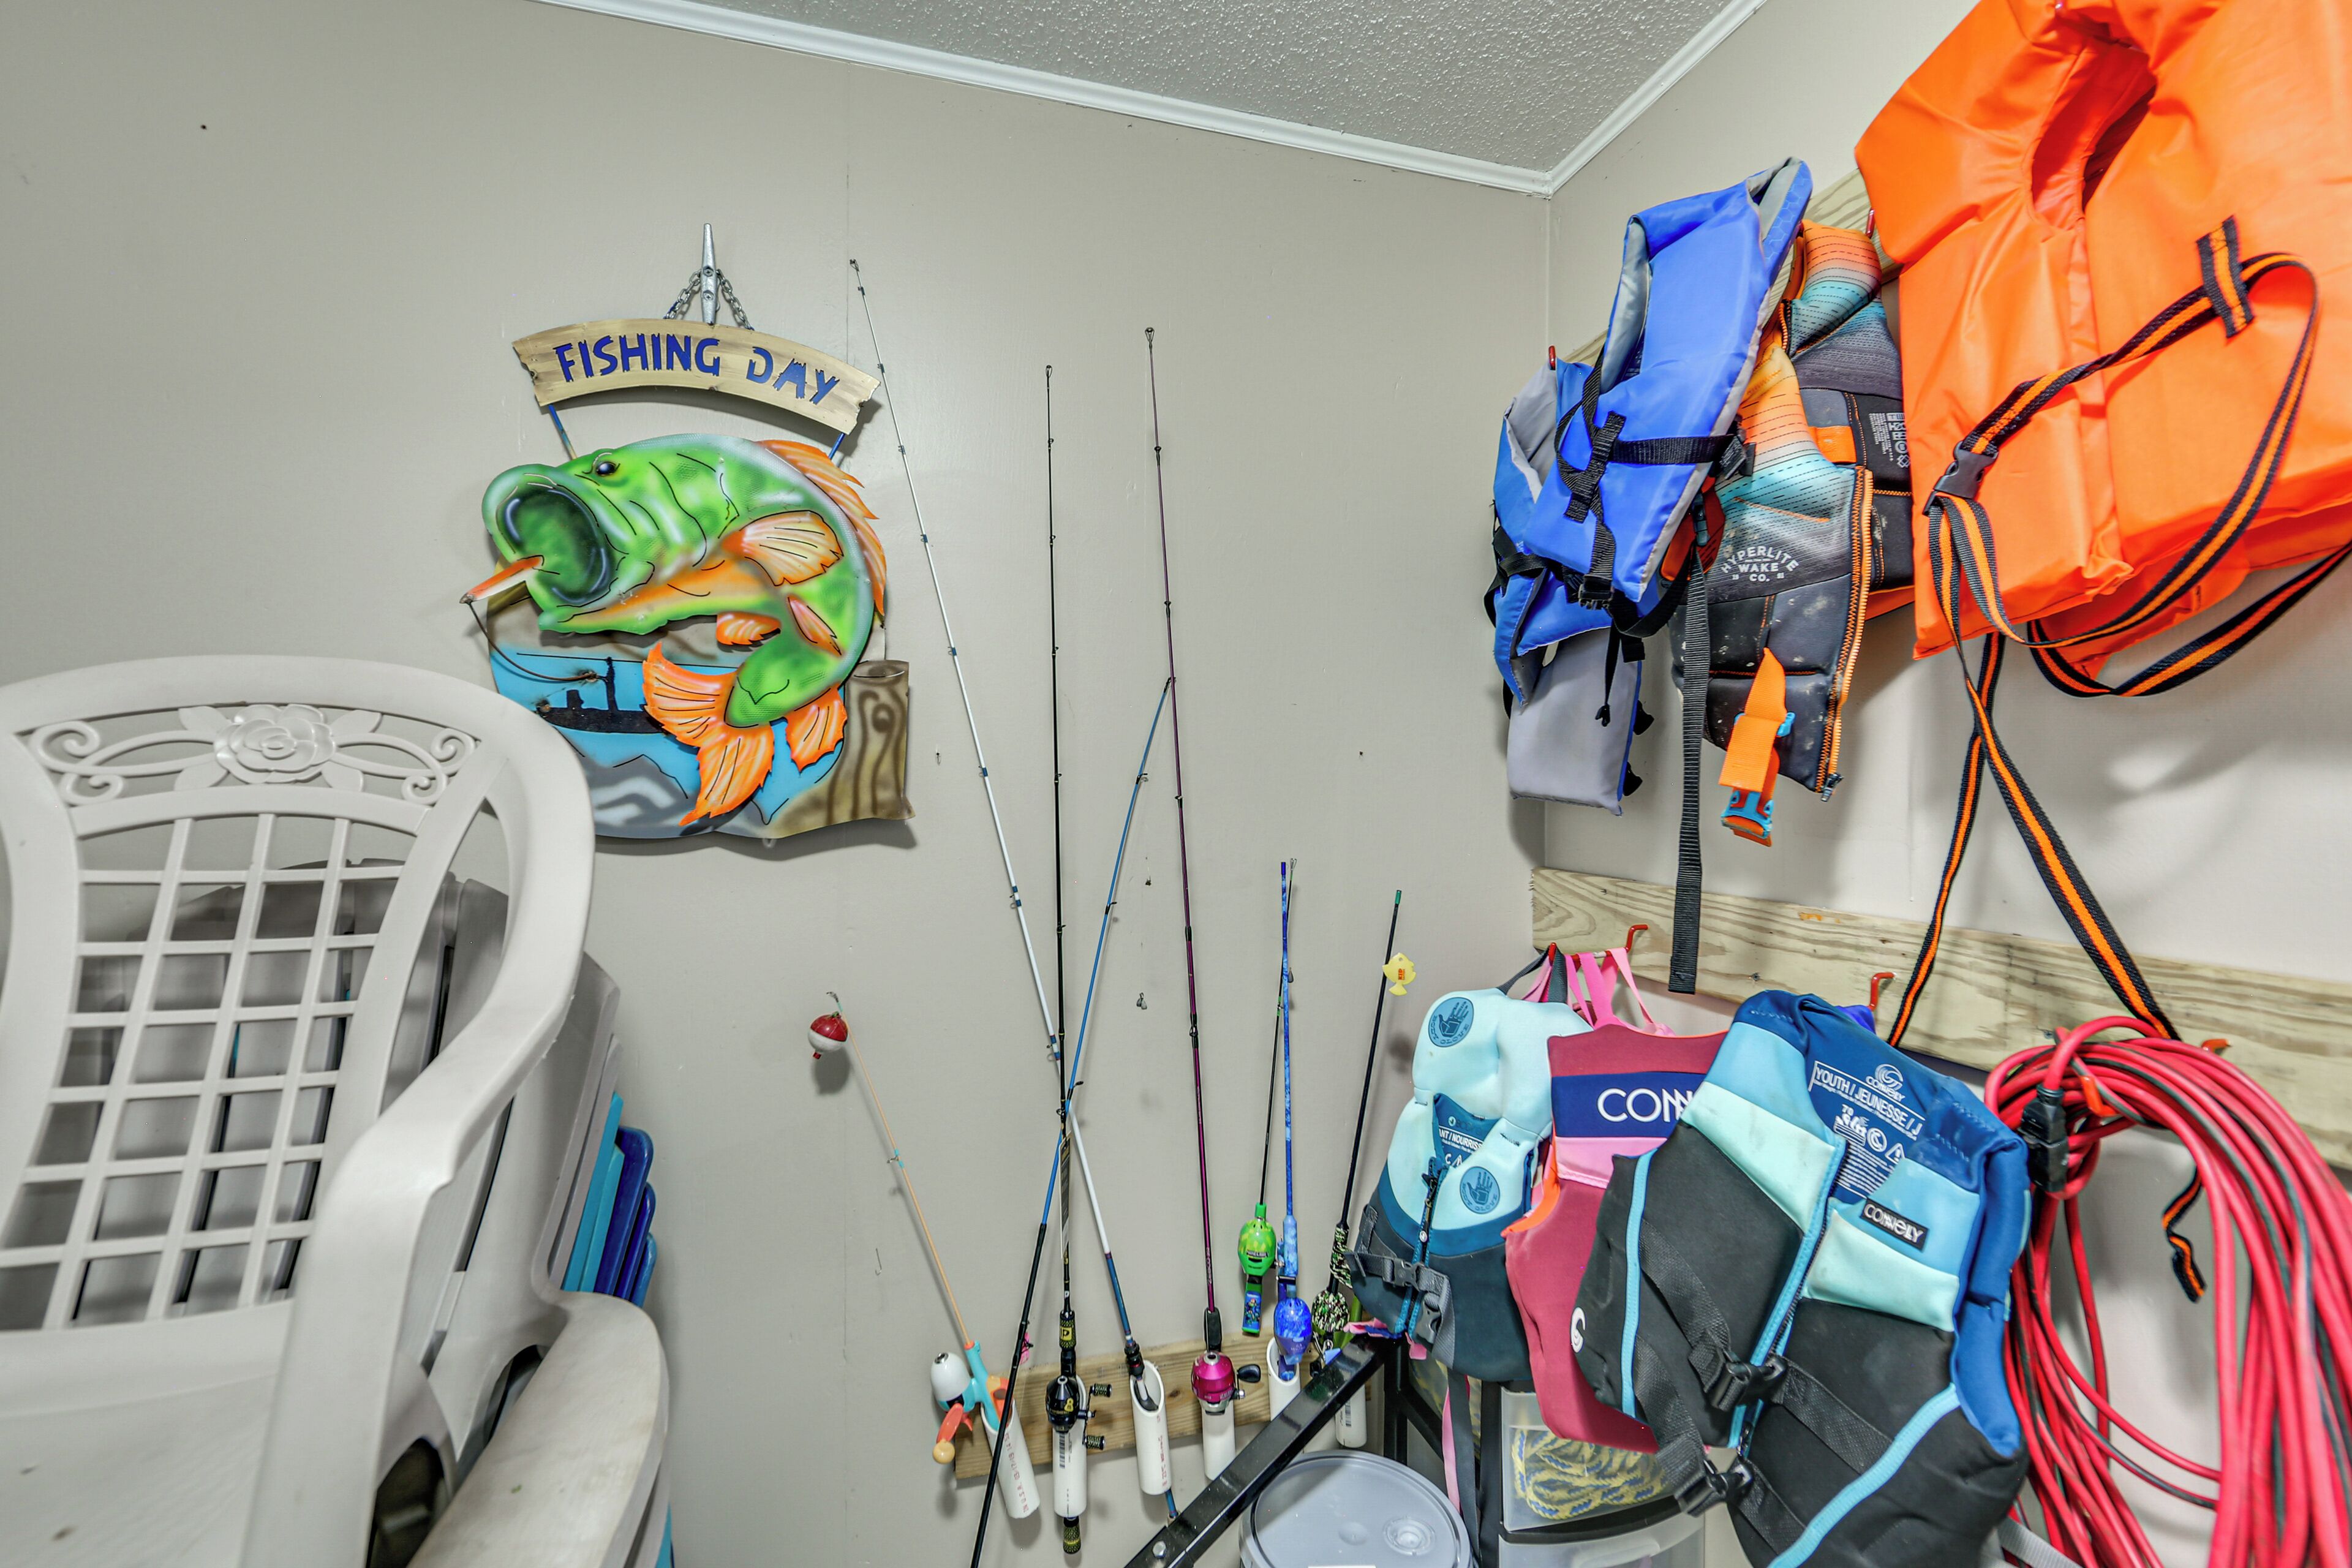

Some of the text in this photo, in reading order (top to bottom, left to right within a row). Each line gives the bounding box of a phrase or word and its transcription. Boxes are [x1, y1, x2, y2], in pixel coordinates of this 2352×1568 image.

[552, 333, 840, 405] FISHING DAY
[1721, 545, 1800, 574] HYPERLITE
[1738, 562, 1779, 573] WAKE
[1749, 573, 1770, 582] CO.
[1815, 1066, 1851, 1094] YOUTH
[1855, 1087, 1909, 1127] JEUNESSE
